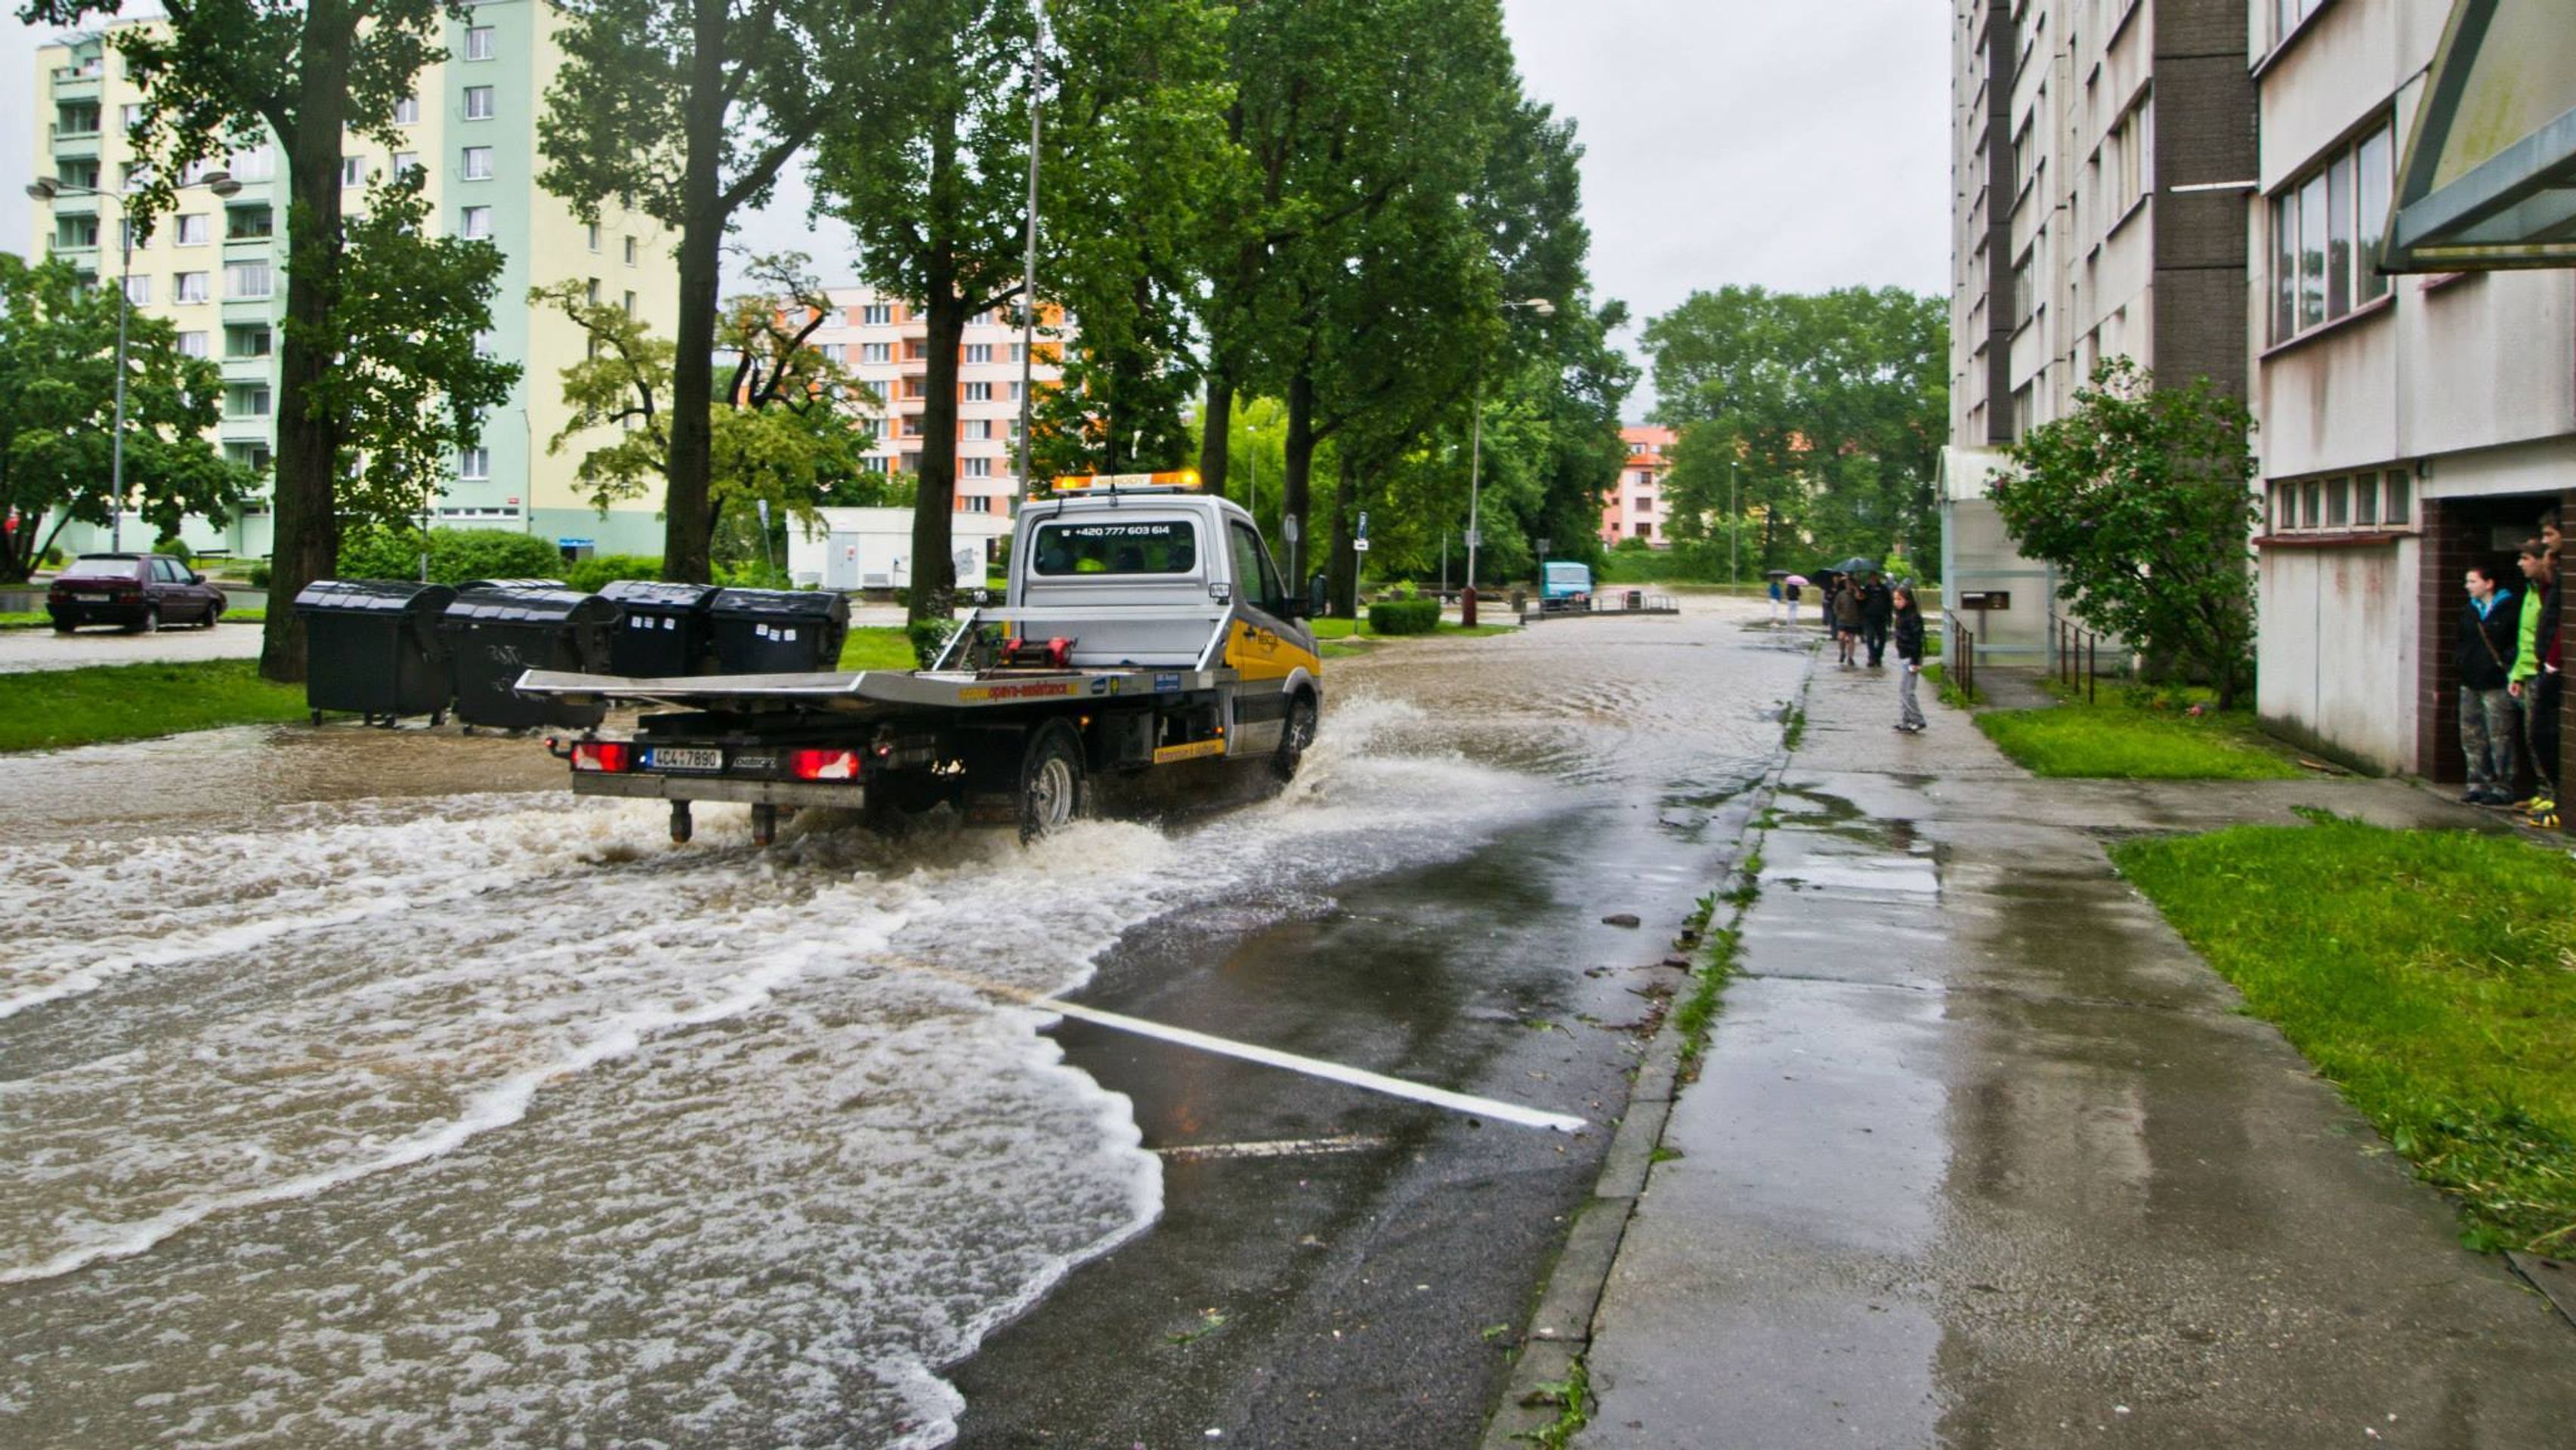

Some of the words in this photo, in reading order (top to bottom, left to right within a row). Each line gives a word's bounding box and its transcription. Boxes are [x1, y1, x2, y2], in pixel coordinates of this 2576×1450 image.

[1076, 528, 1103, 536] +420
[1105, 527, 1126, 535] 777
[1127, 526, 1149, 535] 603
[1151, 526, 1169, 534] 614
[656, 750, 677, 767] 4C4
[687, 751, 716, 767] 7890
